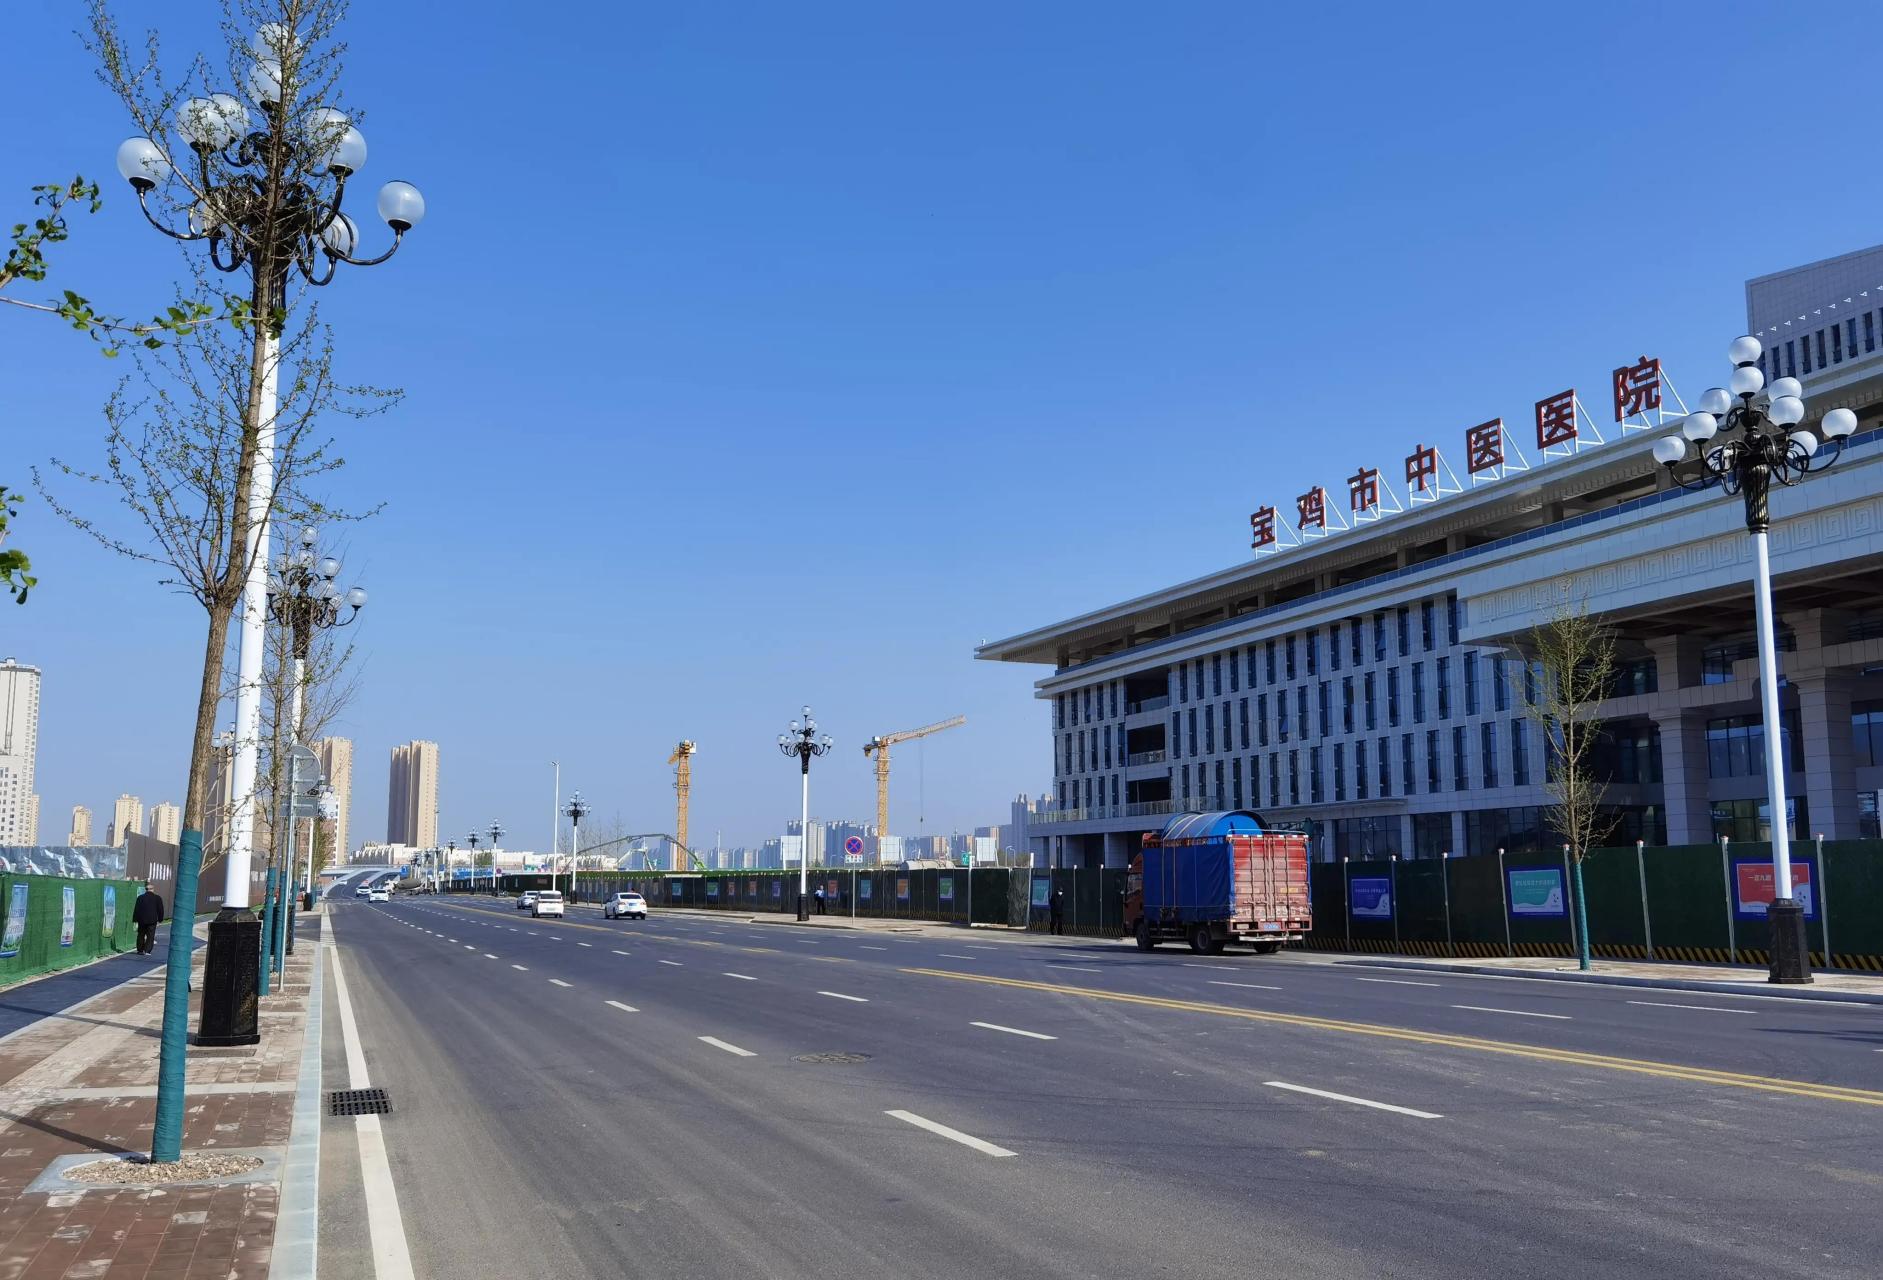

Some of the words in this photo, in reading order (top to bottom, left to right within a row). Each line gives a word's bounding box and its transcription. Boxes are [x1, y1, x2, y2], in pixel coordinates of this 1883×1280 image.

[1250, 355, 1661, 549] 宝鸡市中医医院
